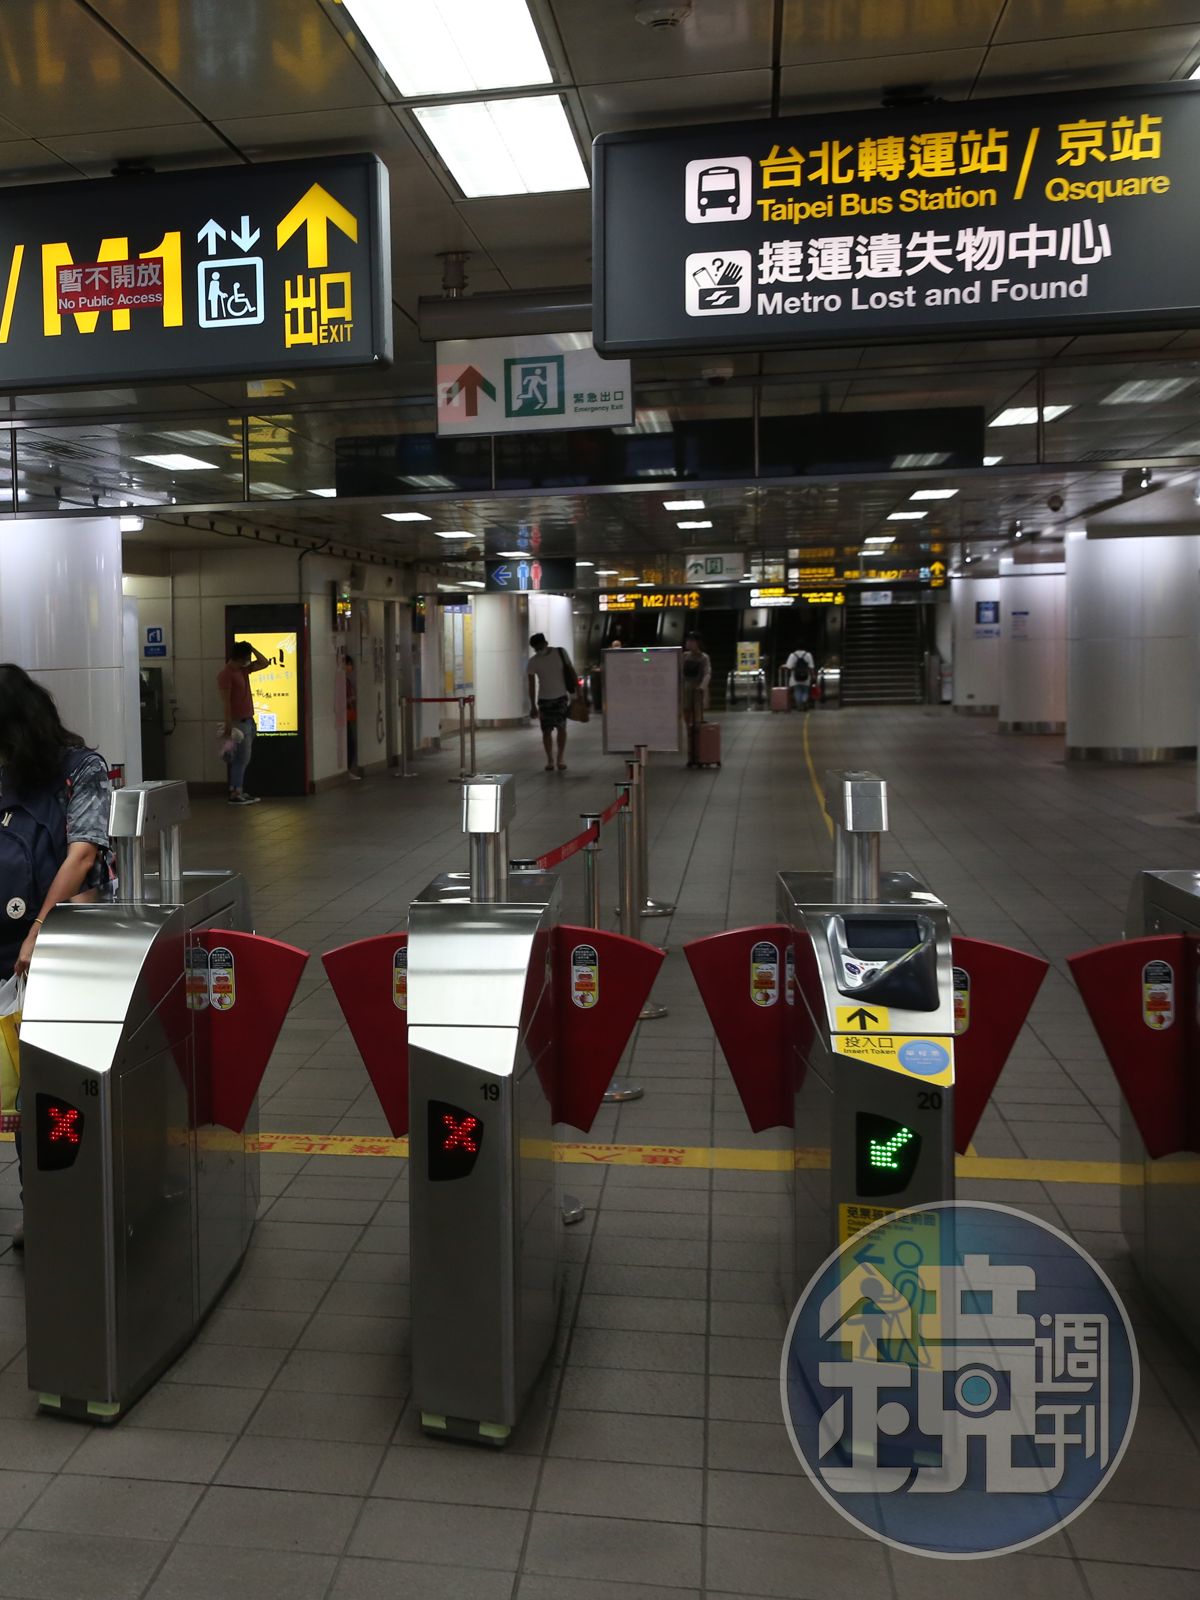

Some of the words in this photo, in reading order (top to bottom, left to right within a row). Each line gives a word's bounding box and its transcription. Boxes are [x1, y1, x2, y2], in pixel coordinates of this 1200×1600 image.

[758, 128, 1009, 190] 台北轉運站
[1056, 113, 1163, 168] 京站
[757, 194, 834, 225] Taipei
[840, 191, 892, 216] Bus
[898, 186, 997, 214] Station
[1045, 172, 1171, 204] Qsquare
[757, 218, 1113, 285] 捷運遺失物中心
[58, 263, 163, 294] 暫不開放
[57, 298, 76, 310] No
[78, 294, 115, 309] Public
[116, 291, 163, 305] Access
[757, 288, 842, 316] Metro
[851, 283, 916, 311] Lost
[924, 279, 982, 307] and
[990, 274, 1089, 303] Found
[284, 271, 352, 349] 出口
[318, 323, 354, 344] EXIT
[572, 390, 625, 405] 緊急出口
[573, 404, 609, 414] Emergency
[610, 403, 624, 411] Exit
[845, 1037, 894, 1048] 投入口
[81, 1079, 99, 1097] 18
[479, 1083, 500, 1102] 19
[917, 1092, 942, 1111] 20
